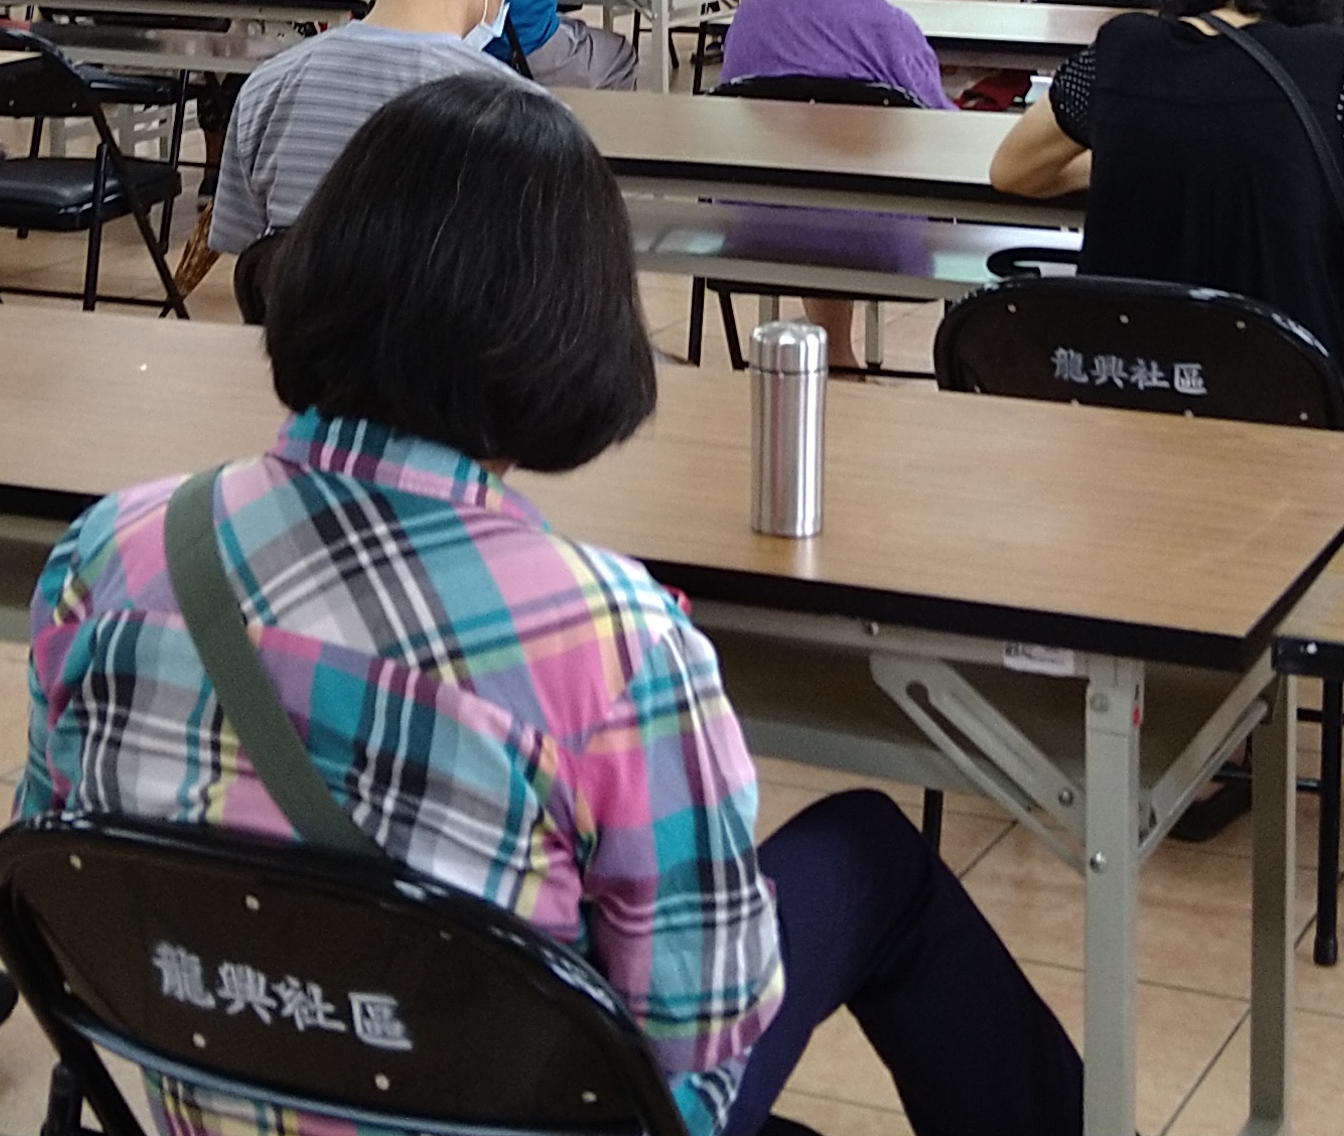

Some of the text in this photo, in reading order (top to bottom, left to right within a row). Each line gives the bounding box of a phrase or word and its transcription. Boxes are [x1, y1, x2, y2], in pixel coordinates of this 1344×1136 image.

[1050, 346, 1208, 395] 龍興社區
[152, 940, 413, 1050] 龍興社區
